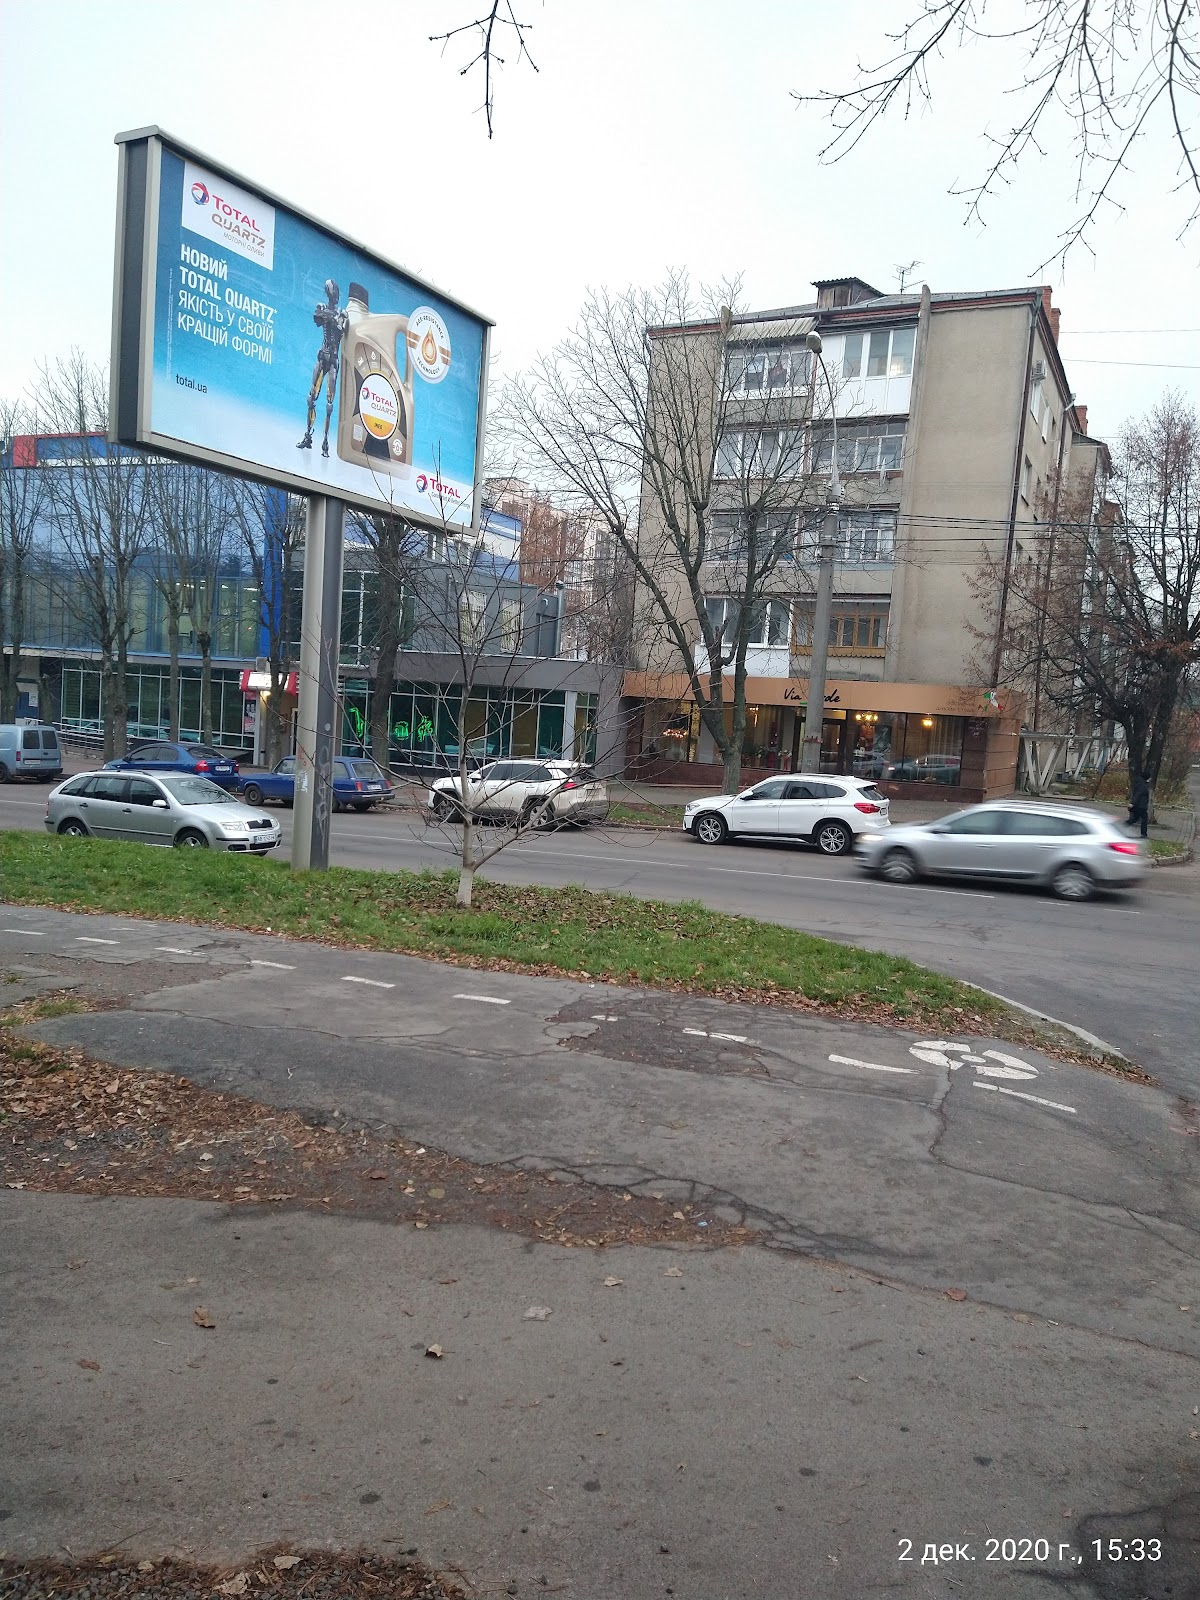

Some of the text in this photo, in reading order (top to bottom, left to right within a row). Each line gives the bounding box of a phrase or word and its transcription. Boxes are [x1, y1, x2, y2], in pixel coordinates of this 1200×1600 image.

[212, 194, 261, 233] TOTAL
[211, 213, 266, 249] QUARTZ
[223, 232, 265, 257] МОТОРНІ ОЛИВИ
[180, 243, 228, 281] НОВИЙ
[179, 266, 222, 301] TOTAL
[178, 290, 274, 345] ЯКІСТЬ У СВОЇЙ
[177, 311, 272, 365] КРАЩІЙ ФОРМІ
[416, 356, 441, 375] TECHNOLOGY
[175, 373, 208, 394] total.ua
[370, 402, 397, 417] QUARTZ
[371, 392, 394, 409] TOTAL
[429, 477, 461, 499] TOTAL
[783, 687, 802, 701] Via
